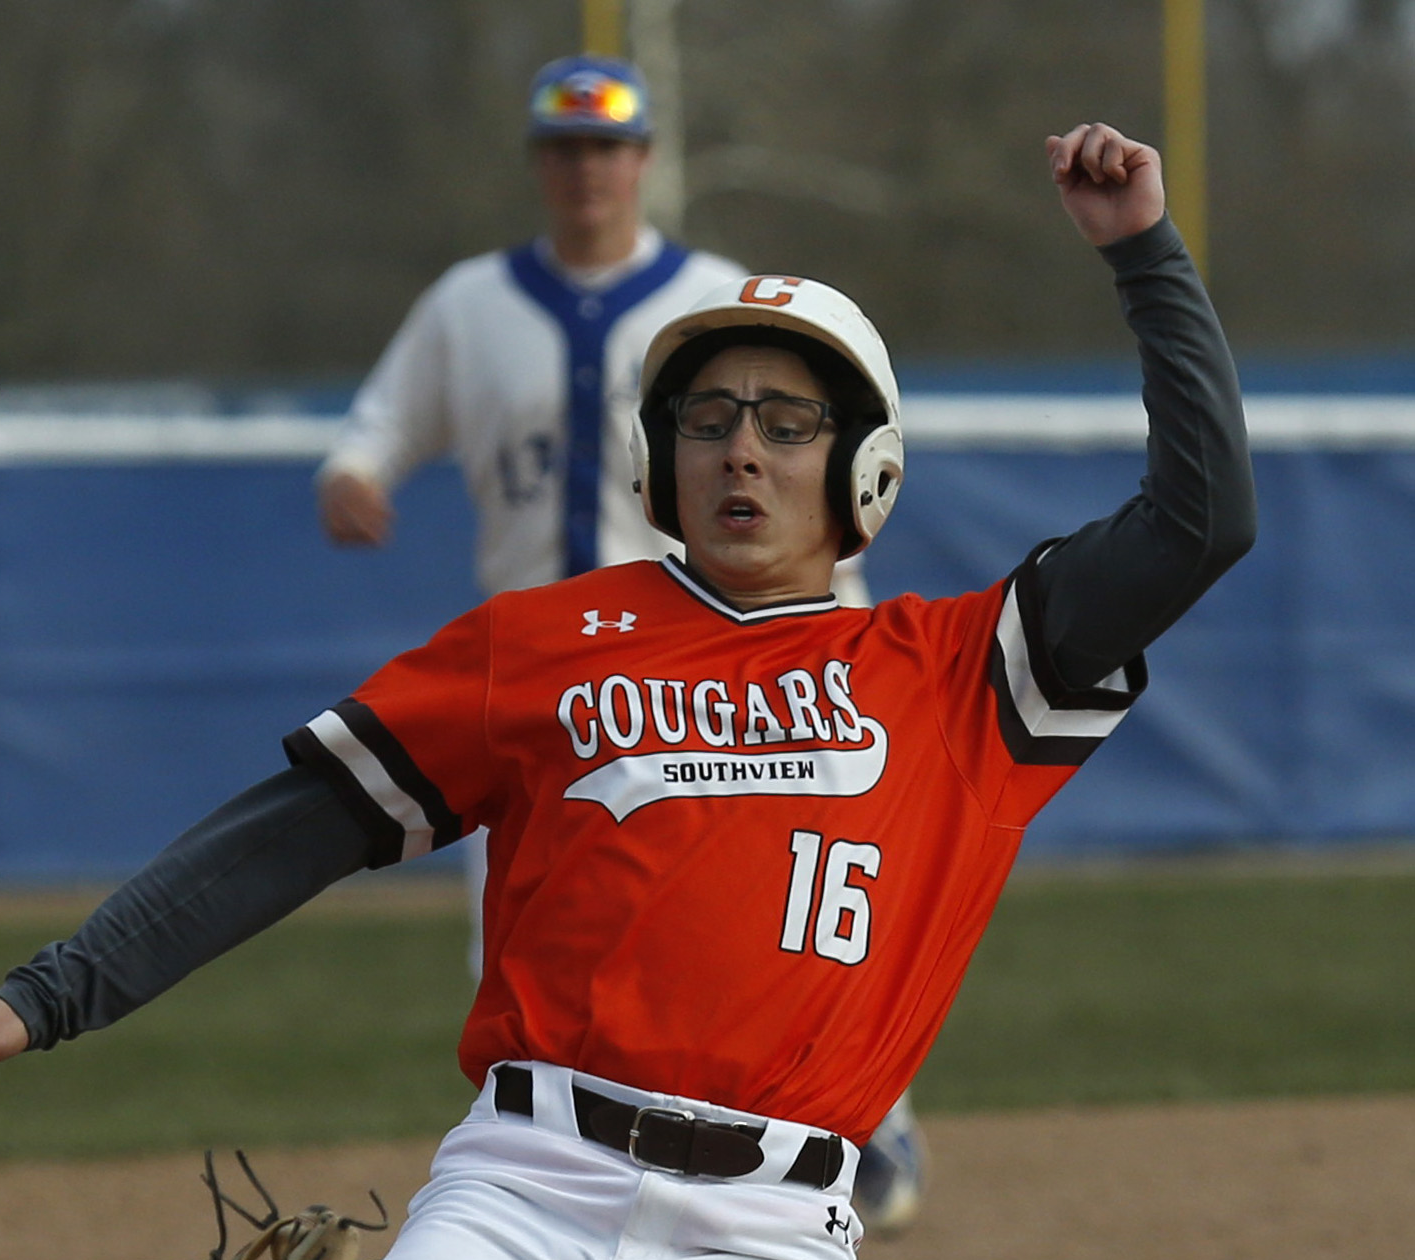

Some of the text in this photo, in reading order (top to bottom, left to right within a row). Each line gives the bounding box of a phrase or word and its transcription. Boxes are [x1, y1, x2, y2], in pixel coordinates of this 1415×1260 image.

[738, 275, 803, 307] C
[557, 659, 864, 759] COUGARS
[663, 760, 815, 783] SOUTHVIEW
[779, 830, 881, 965] 16
